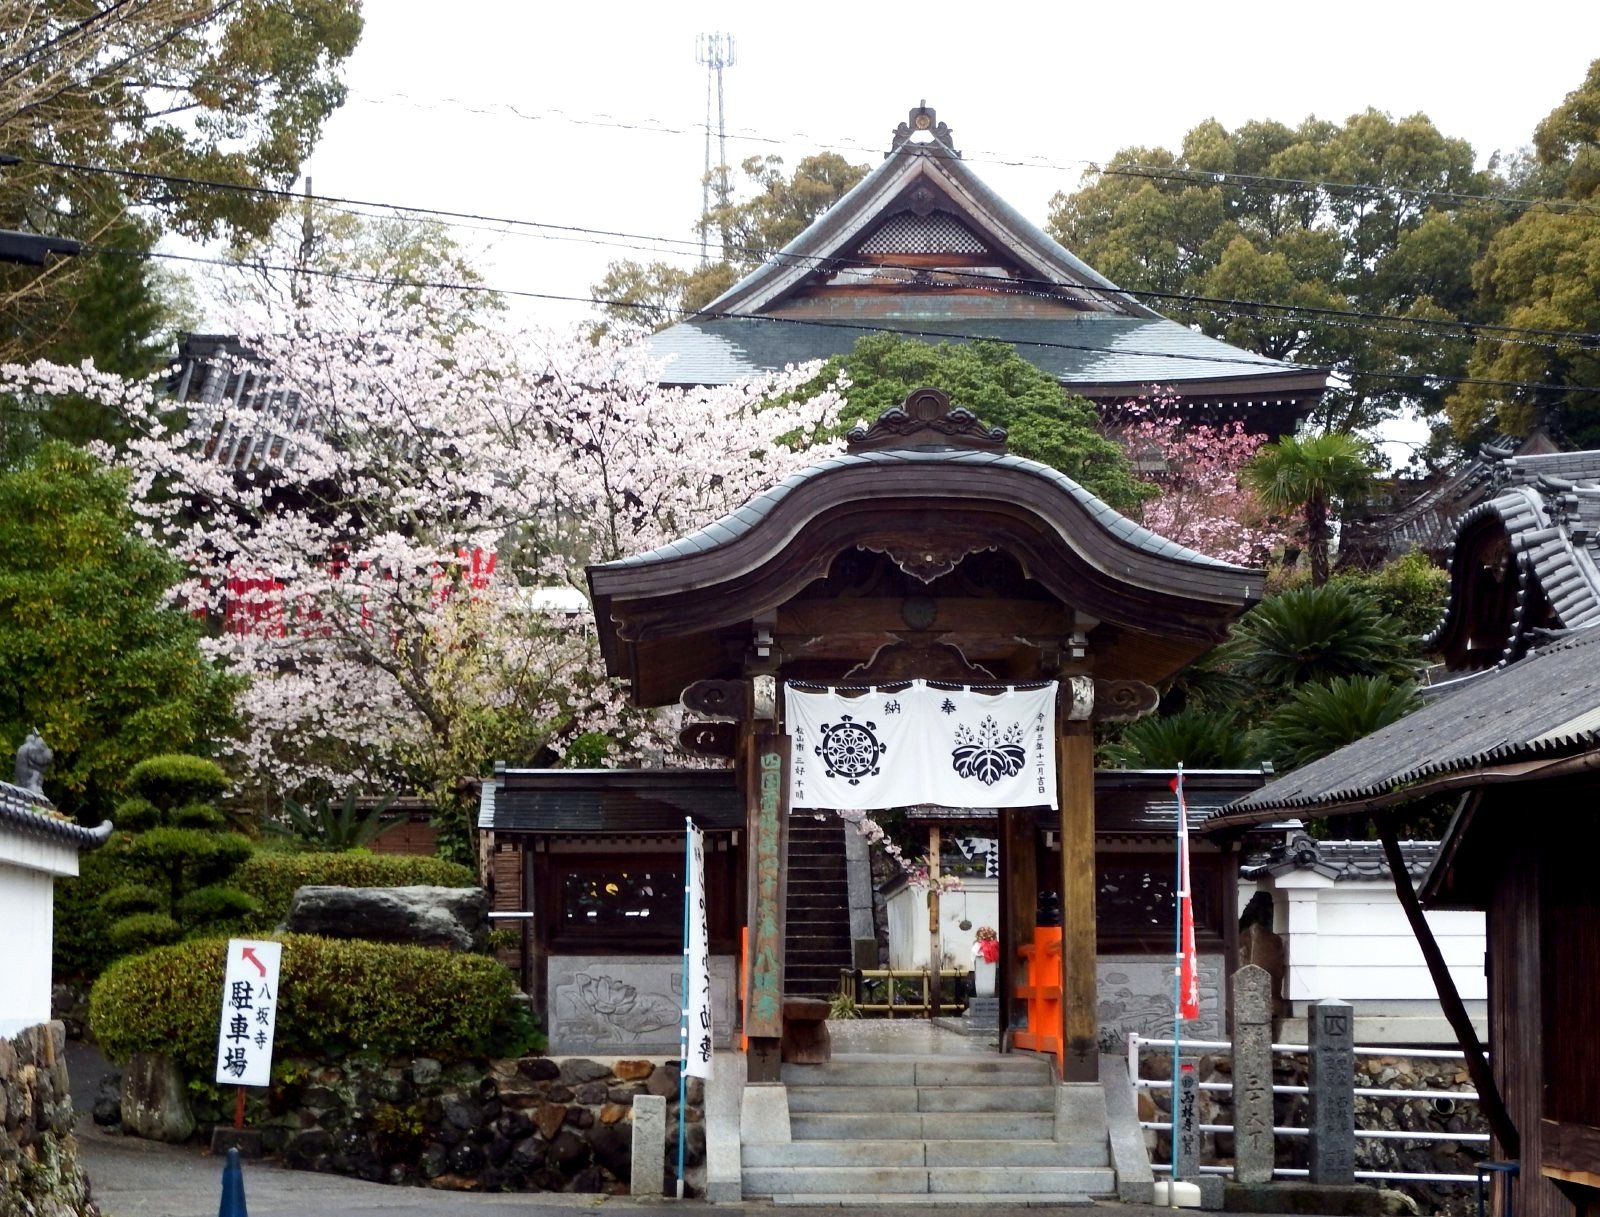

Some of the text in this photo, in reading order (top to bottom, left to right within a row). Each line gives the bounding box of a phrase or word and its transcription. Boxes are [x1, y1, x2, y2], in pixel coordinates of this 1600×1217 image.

[884, 699, 901, 716] 納
[940, 697, 957, 716] 奉
[222, 980, 255, 1079] 駐車場
[254, 983, 271, 1050] 八坂寺
